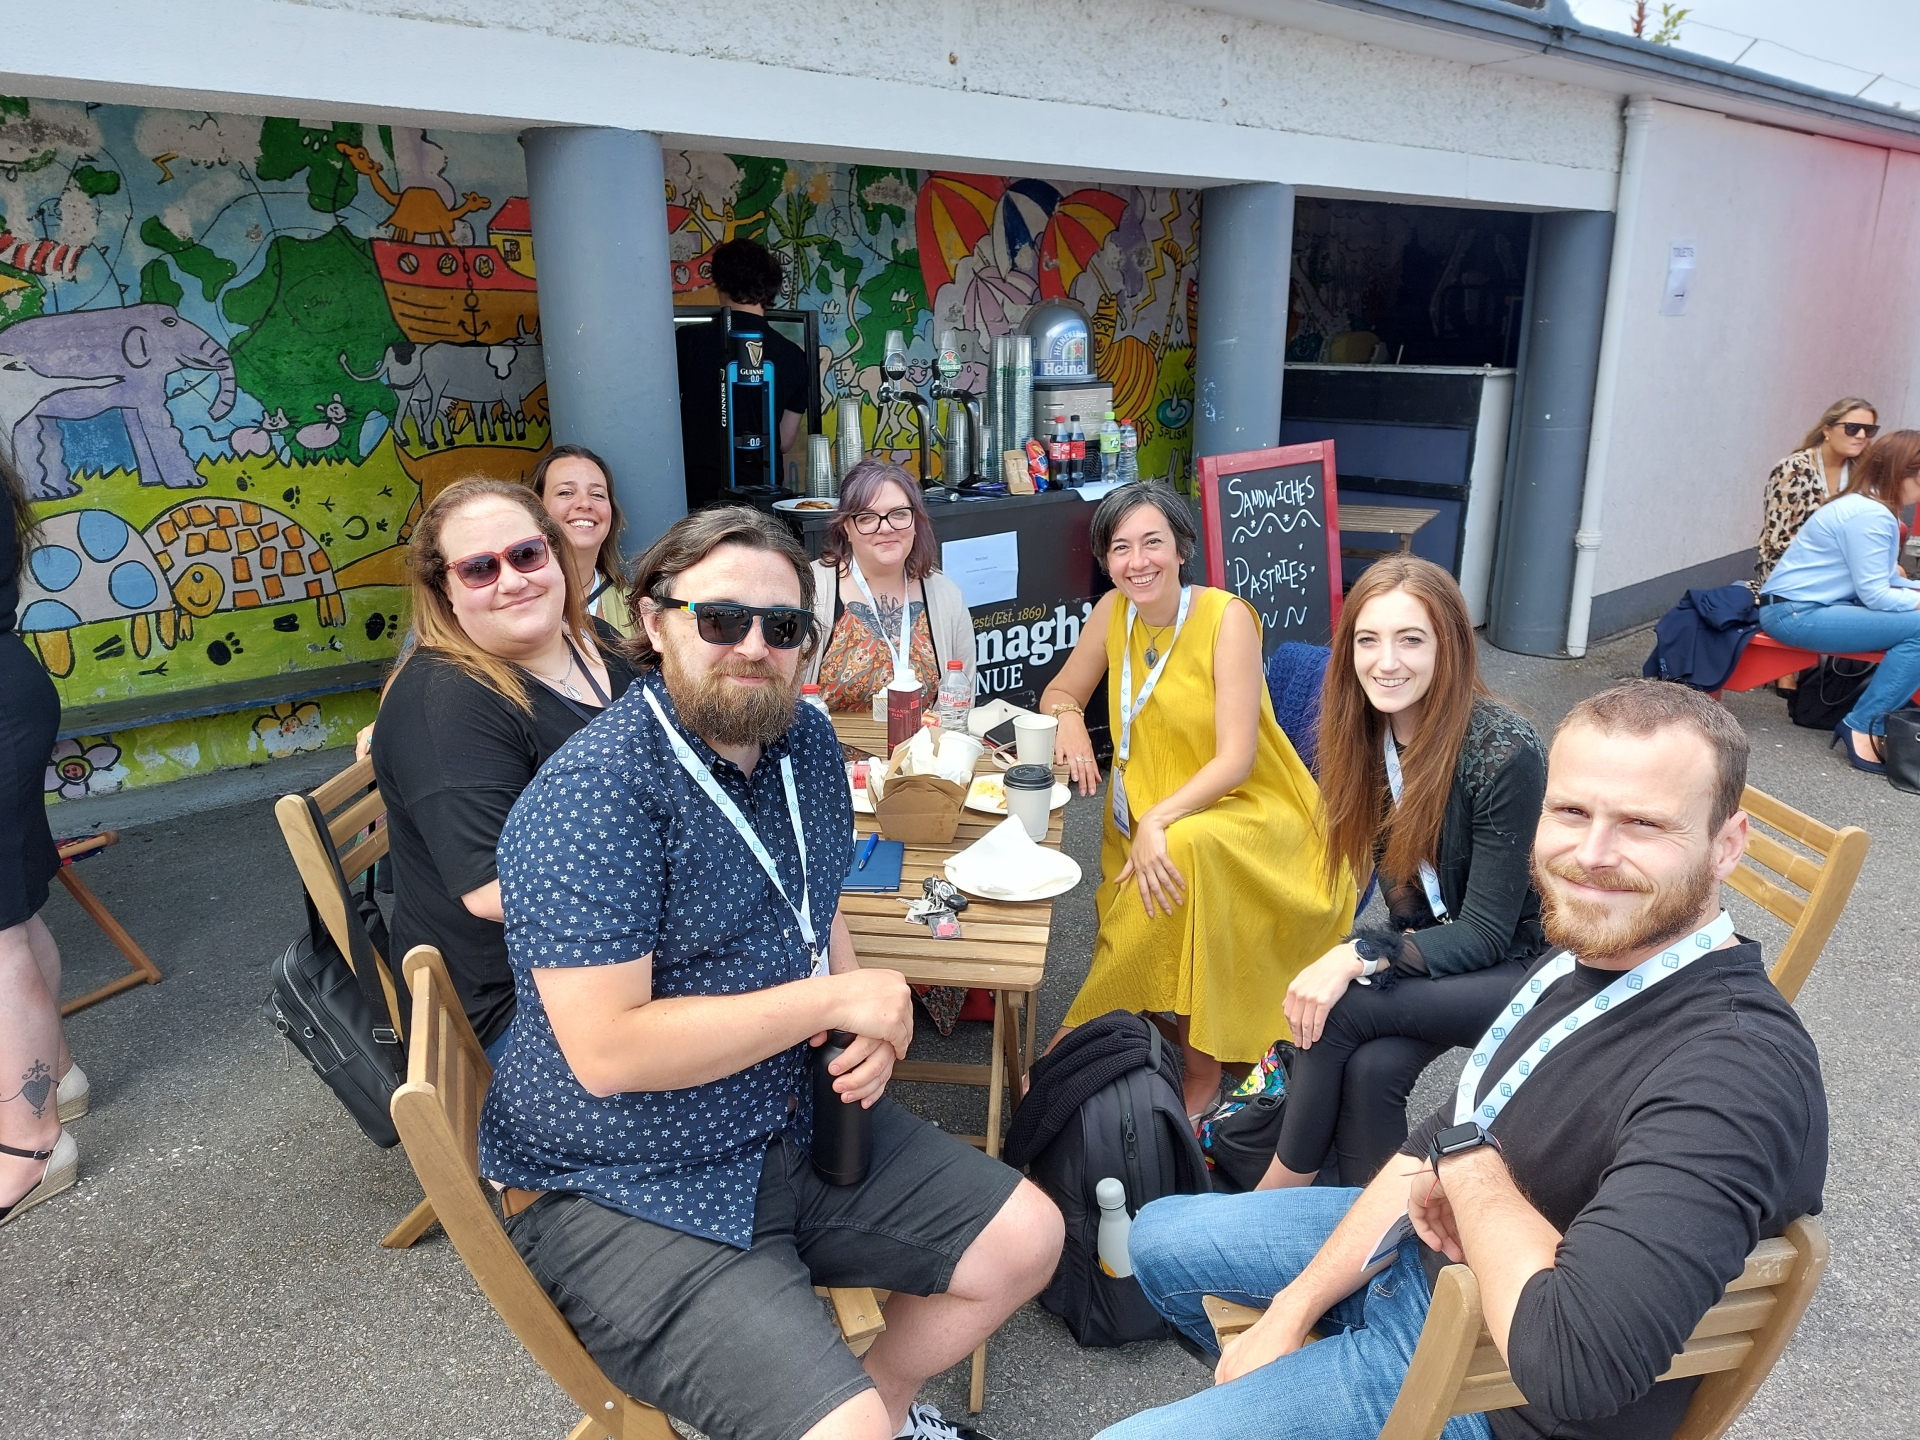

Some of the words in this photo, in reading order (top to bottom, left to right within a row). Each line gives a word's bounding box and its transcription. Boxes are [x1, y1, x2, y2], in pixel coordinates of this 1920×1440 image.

[1159, 427, 1187, 440] SPLISH
[1228, 475, 1315, 518] SANDWICHES
[1234, 556, 1308, 599] PASTRIES
[991, 611, 1015, 627] (Est.
[1017, 602, 1047, 621] 1869)
